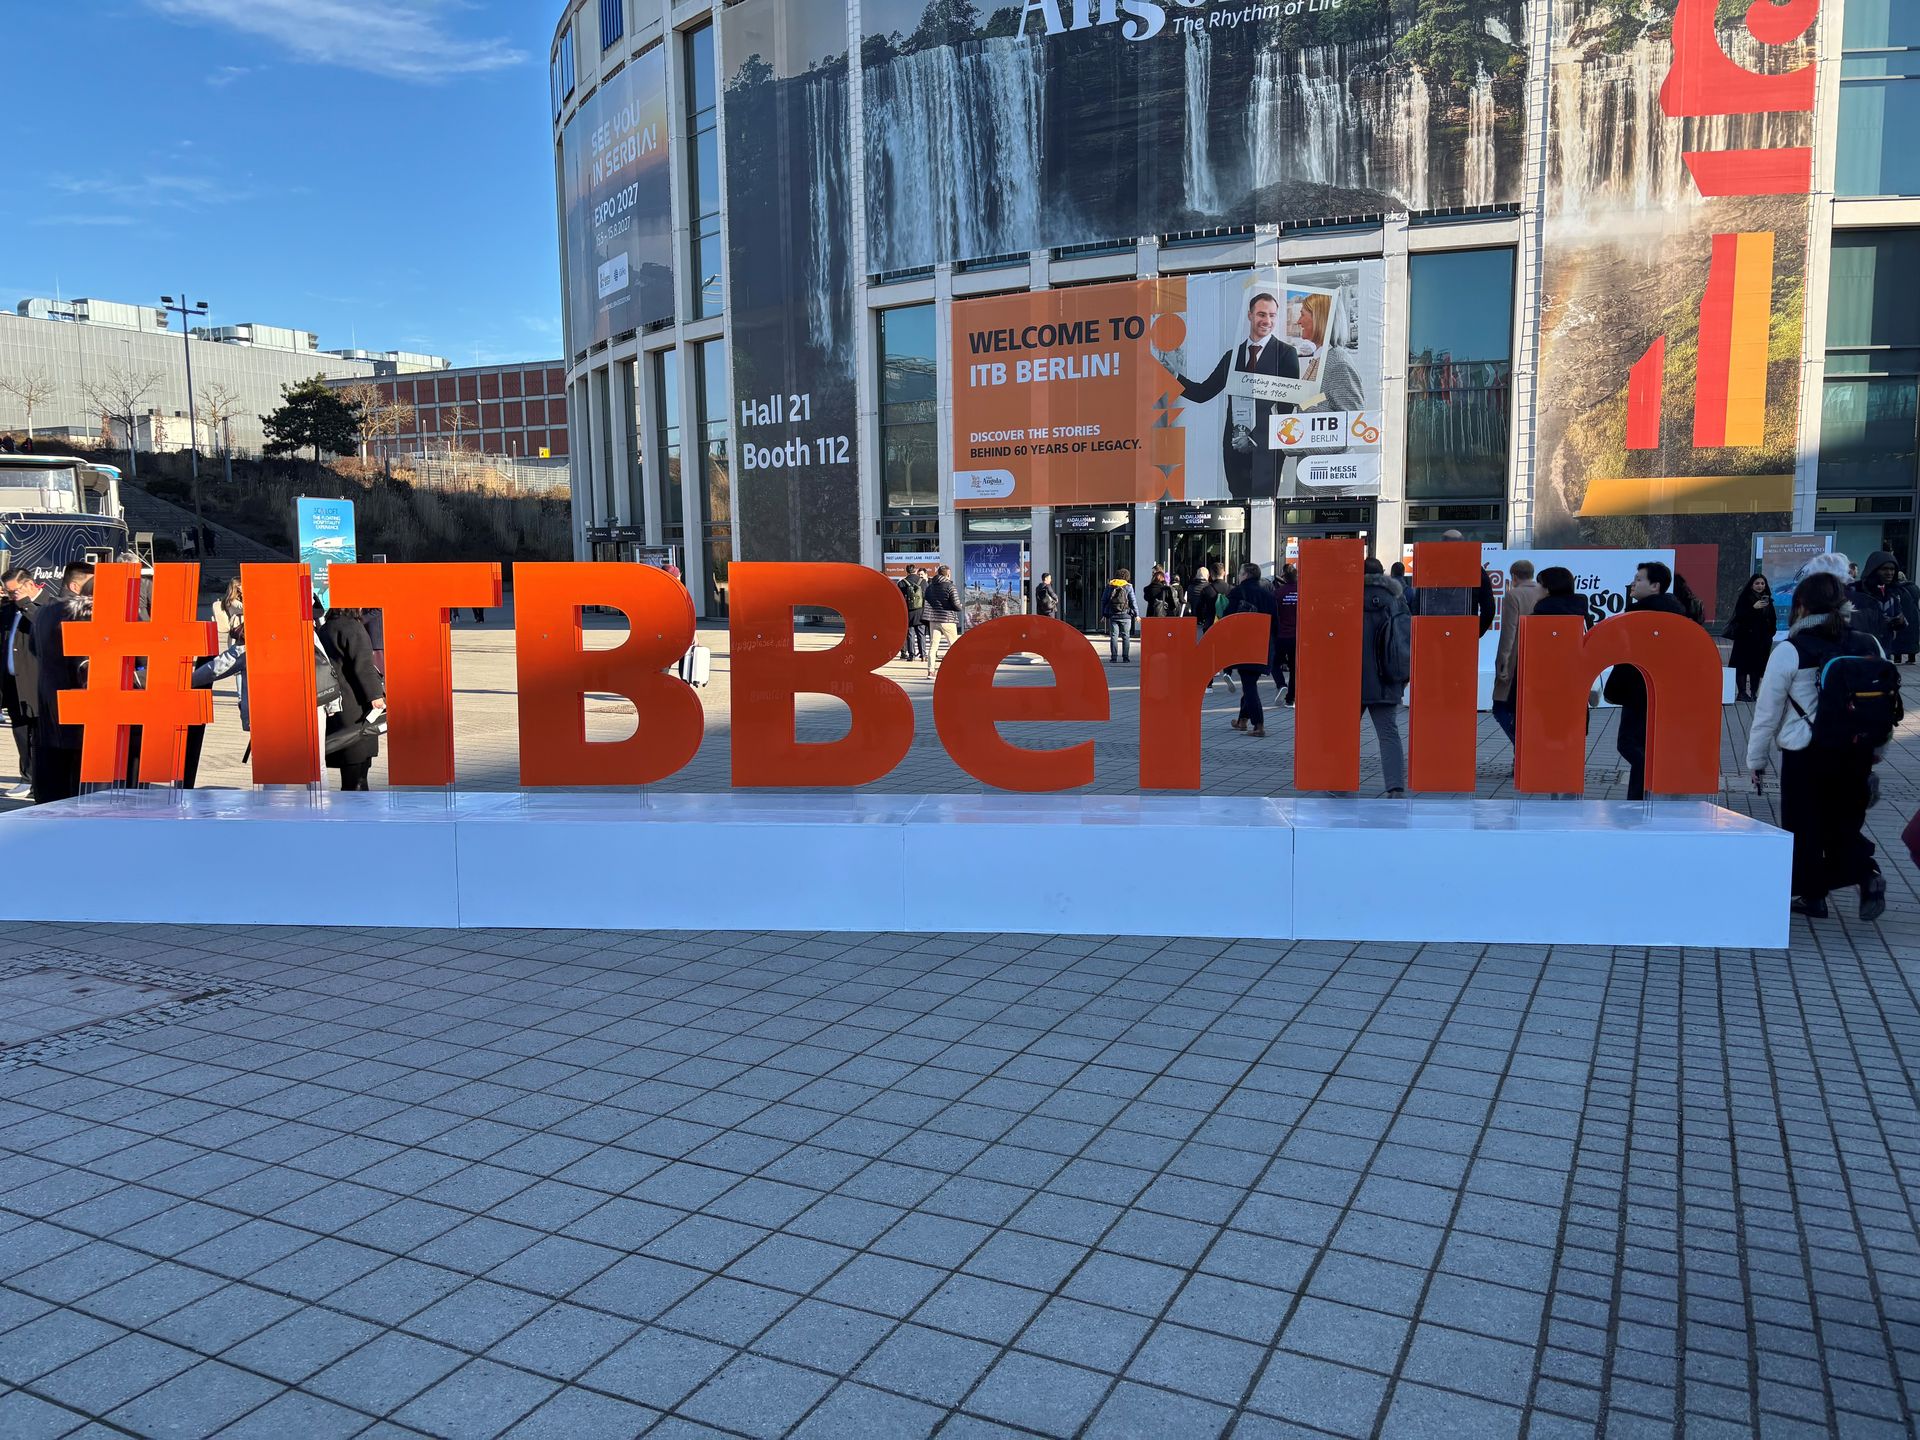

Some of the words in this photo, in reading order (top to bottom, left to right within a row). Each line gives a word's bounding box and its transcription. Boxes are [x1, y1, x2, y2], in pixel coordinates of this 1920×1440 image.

[1173, 15, 1204, 34] The
[1209, 3, 1280, 28] Rhythm
[1284, 0, 1304, 16] of
[592, 121, 611, 157] SEE
[613, 99, 640, 138] YOU
[593, 158, 602, 187] IN
[606, 123, 656, 177] SERBIA!
[594, 197, 616, 228] EXPO
[617, 181, 639, 213] 2027
[968, 319, 1100, 354] WELCOME
[1108, 315, 1145, 341] TO
[970, 362, 1007, 388] ITB
[1016, 352, 1121, 384] BERLIN!
[1241, 374, 1270, 388] Creating
[1271, 381, 1302, 390] moments
[1251, 388, 1268, 396] since
[1270, 389, 1288, 398] 1966
[741, 394, 783, 427] Hall
[789, 393, 811, 422] 21
[970, 428, 1024, 443] DISCOVER
[1027, 427, 1049, 439] THE
[1052, 424, 1100, 438] STORIES
[1311, 416, 1338, 432] ITB
[970, 446, 1011, 458] BEHIND
[1014, 446, 1028, 456] 60
[1030, 443, 1069, 454] YEARS
[1072, 441, 1088, 453] OF
[1090, 438, 1142, 452] LEGACY.
[1310, 434, 1338, 443] BERLIN
[743, 436, 811, 470] Booth
[816, 435, 850, 465] 112
[982, 478, 1002, 486] Angola
[1330, 472, 1357, 480] BERLIN
[34, 566, 53, 580] Pure
[1574, 574, 1600, 590] isit
[57, 537, 1722, 795] #ITBBerlin
[318, 687, 335, 698] EAD
